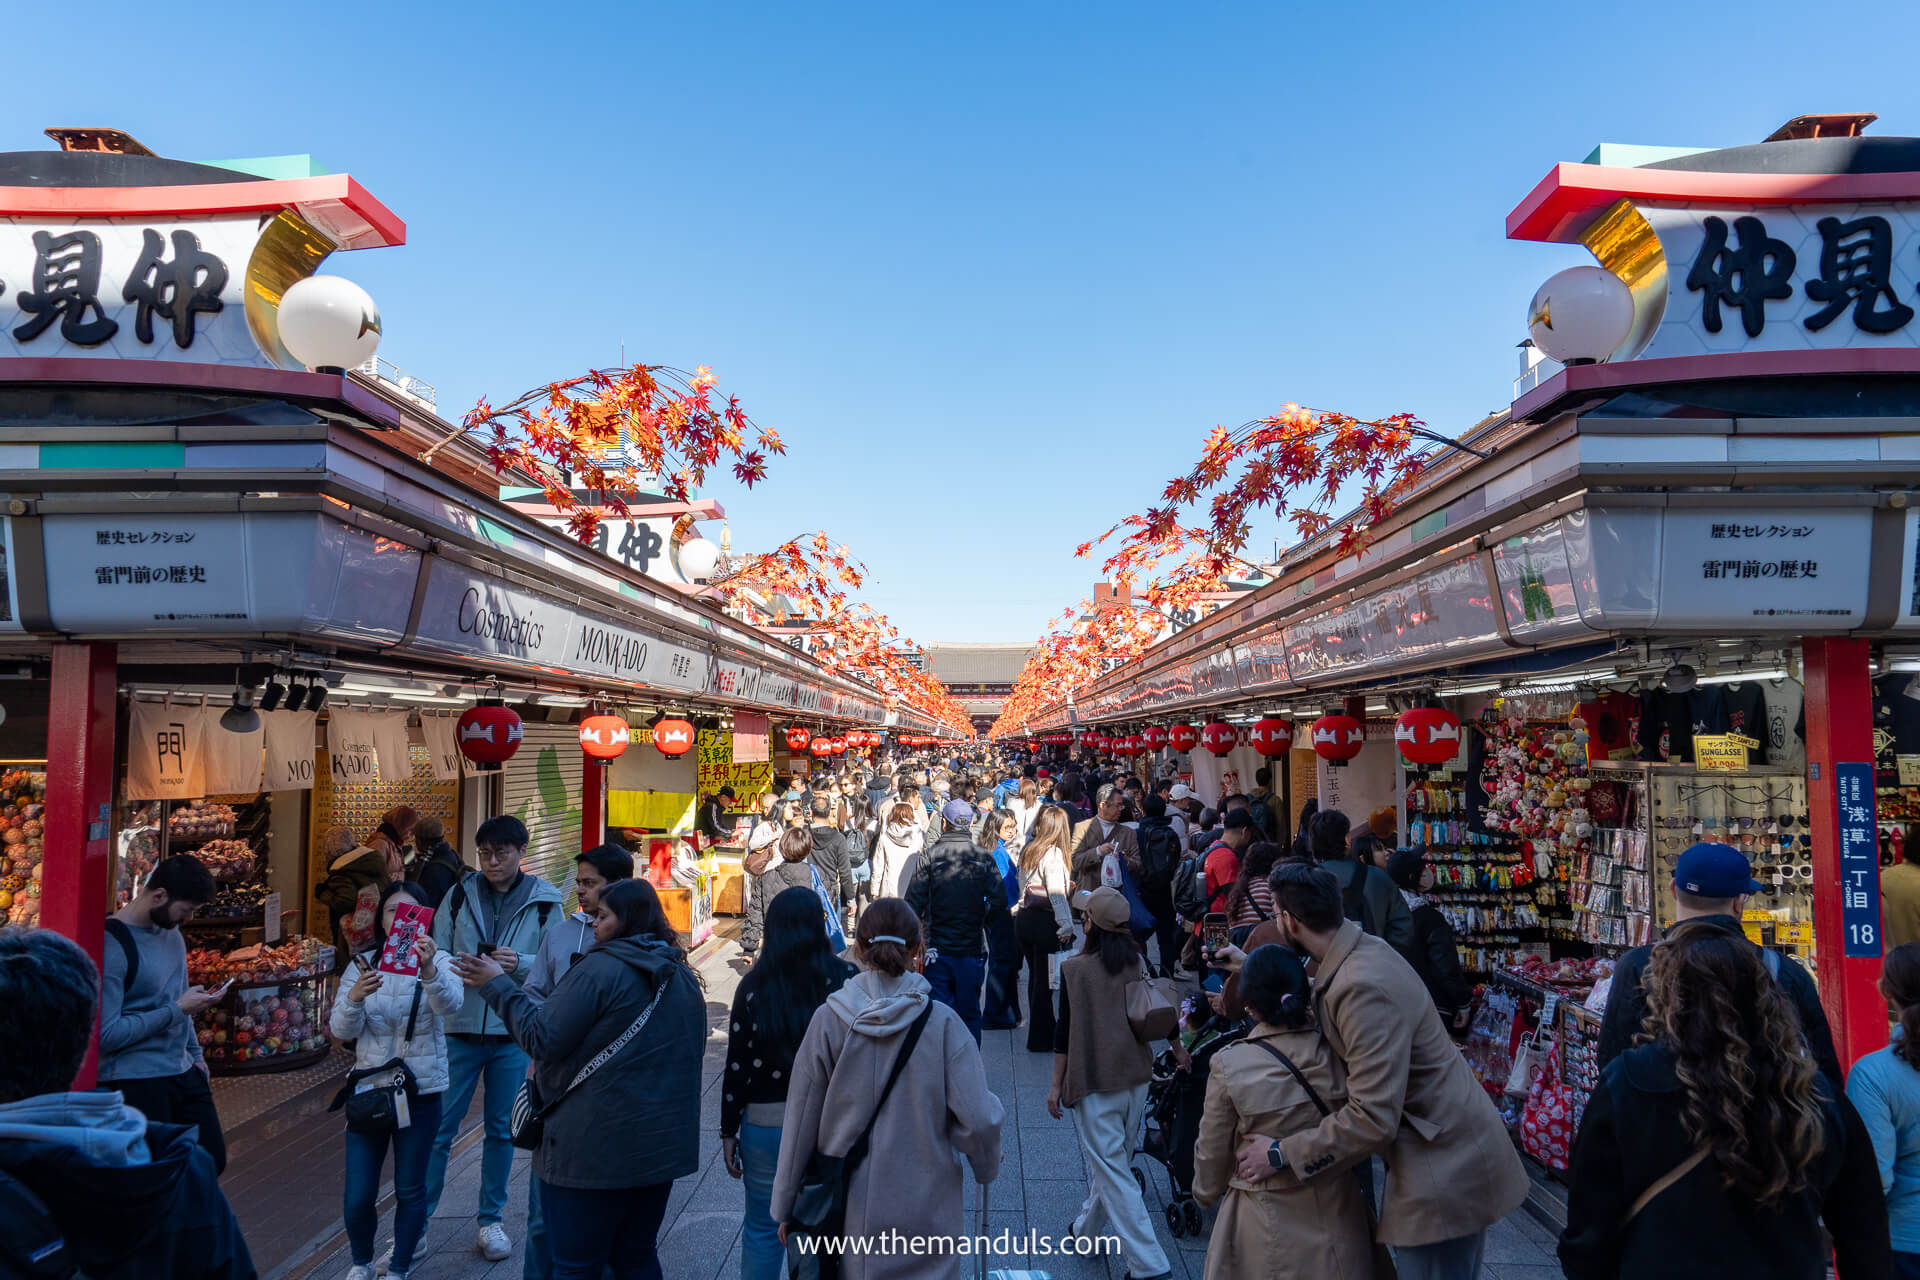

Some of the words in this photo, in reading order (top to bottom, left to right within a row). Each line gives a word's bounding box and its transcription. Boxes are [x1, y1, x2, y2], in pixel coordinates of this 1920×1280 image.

[1686, 214, 1920, 338] 仲見
[95, 529, 197, 546] 歴史セレクション
[1711, 523, 1814, 539] 歴史セレクション
[95, 565, 208, 585] 雷門前の歴史
[1702, 559, 1818, 580] 雷門前の歴史
[458, 586, 545, 650] Cosmetics
[576, 624, 648, 673] MONKADO
[699, 730, 733, 747] ようこ
[1842, 828, 1850, 859] ASAKUSA
[1848, 806, 1869, 909] 浅草一丁目
[1850, 924, 1874, 945] 18
